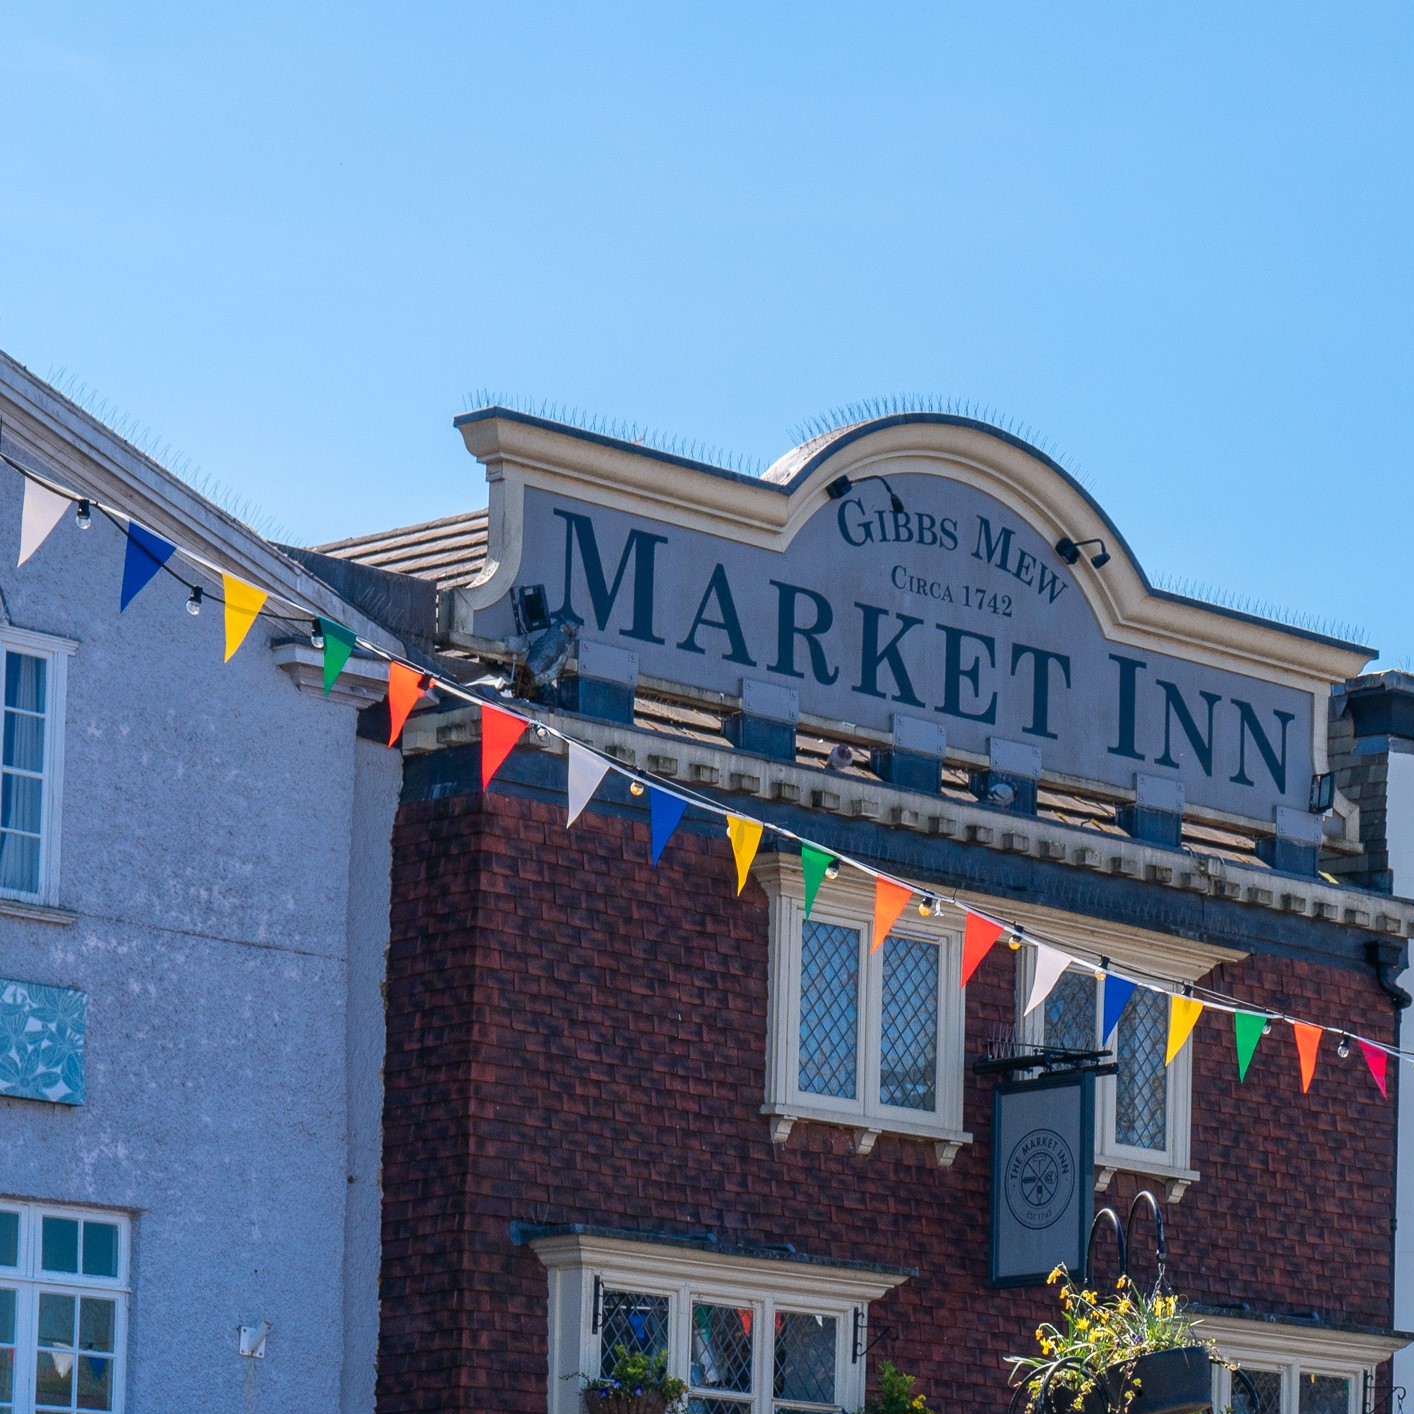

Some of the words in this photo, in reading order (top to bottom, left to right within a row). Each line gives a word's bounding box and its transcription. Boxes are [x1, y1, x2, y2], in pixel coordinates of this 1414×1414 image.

[837, 497, 958, 551] GIBBS
[970, 515, 1069, 605] MEW
[890, 563, 954, 604] CIRCA
[962, 585, 1014, 618] 1742
[553, 508, 1071, 740] MARKET
[1108, 653, 1295, 794] INN
[1010, 1156, 1022, 1179] THE
[1021, 1137, 1058, 1156] MARKET
[1056, 1150, 1070, 1175] INN
